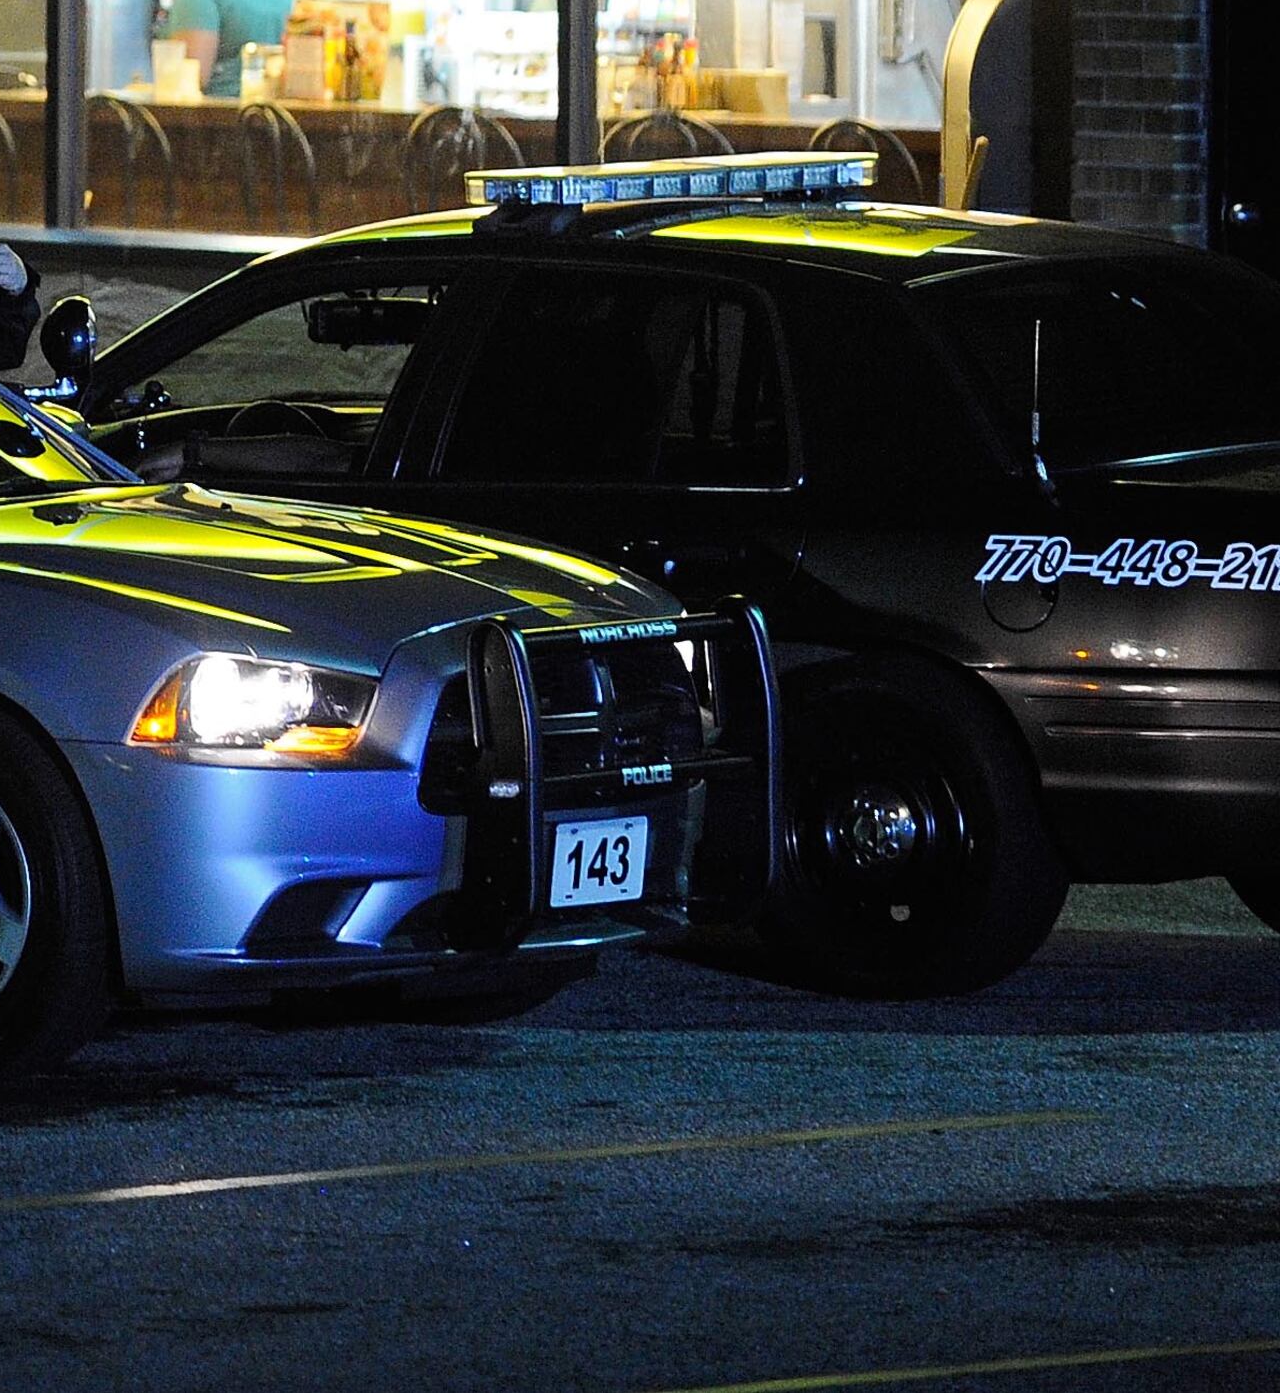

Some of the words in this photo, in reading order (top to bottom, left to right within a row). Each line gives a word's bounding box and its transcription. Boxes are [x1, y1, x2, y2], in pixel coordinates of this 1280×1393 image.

[579, 620, 677, 643] NORCROSS
[622, 764, 673, 786] POLICE
[567, 834, 631, 890] 143
